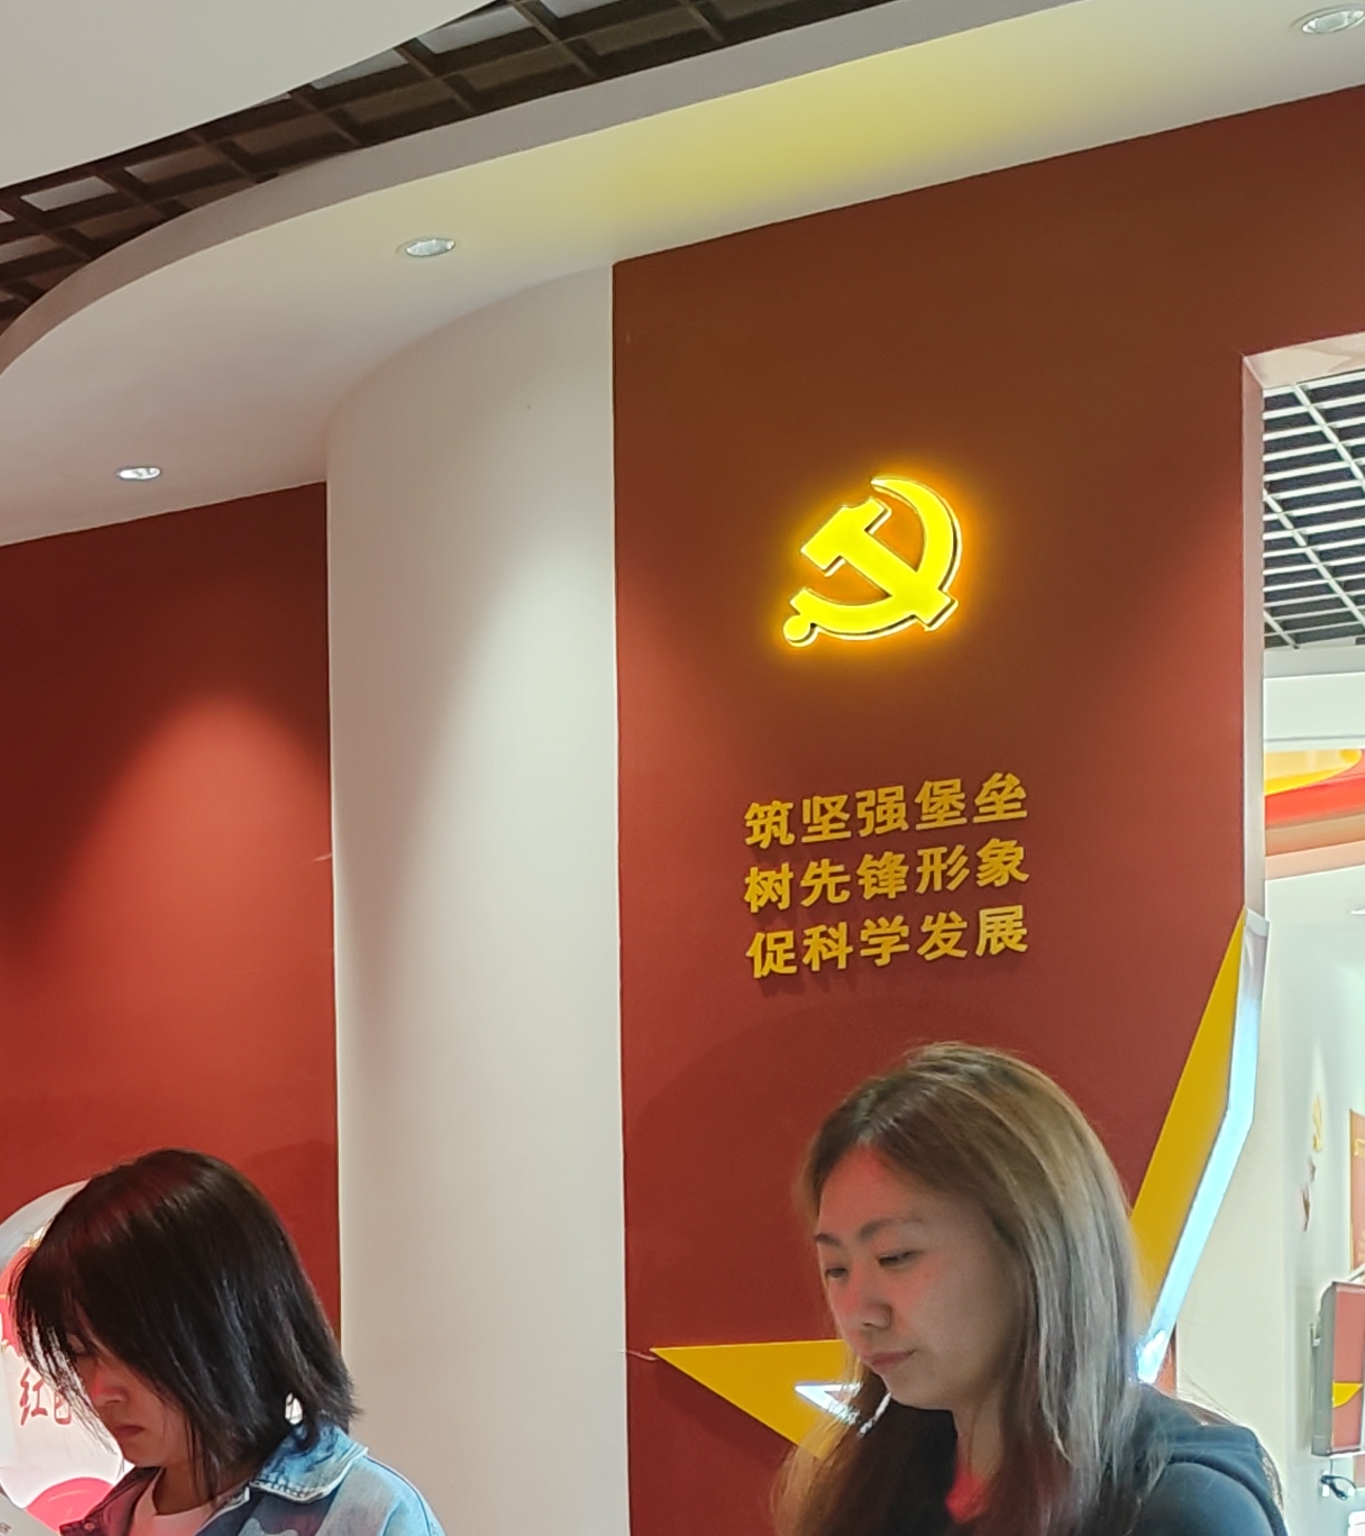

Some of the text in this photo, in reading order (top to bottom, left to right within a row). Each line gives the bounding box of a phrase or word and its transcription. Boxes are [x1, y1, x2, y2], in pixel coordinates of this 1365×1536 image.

[744, 772, 1028, 849] 筑坚强堡垒
[744, 838, 1030, 914] 树先锋形象
[746, 904, 1029, 979] 促科学发展
